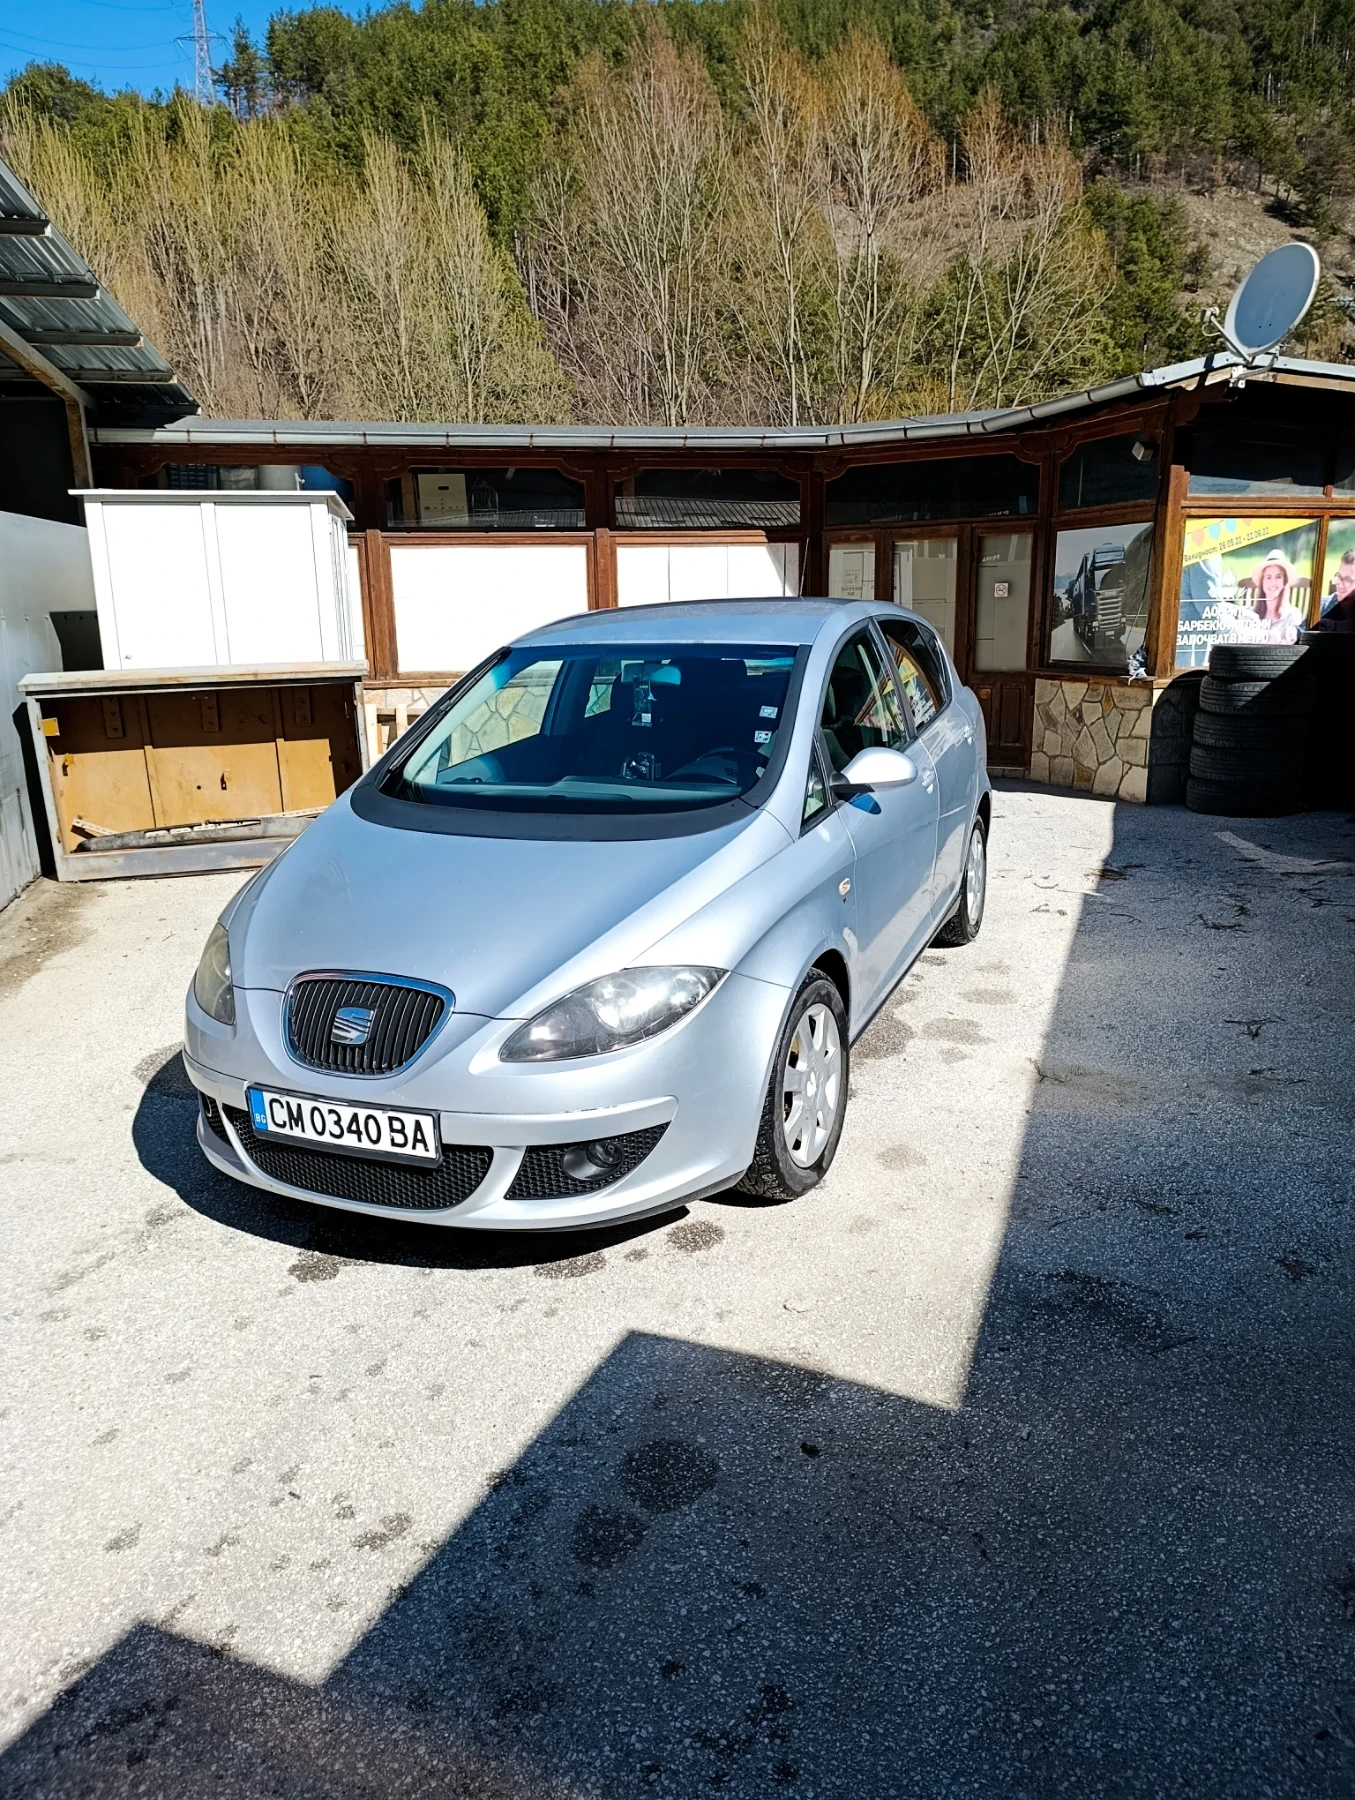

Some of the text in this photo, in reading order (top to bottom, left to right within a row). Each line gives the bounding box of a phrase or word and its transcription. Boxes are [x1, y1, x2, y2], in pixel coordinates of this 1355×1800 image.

[255, 1113, 267, 1124] BG
[269, 1098, 430, 1152] CM 0340 BA
